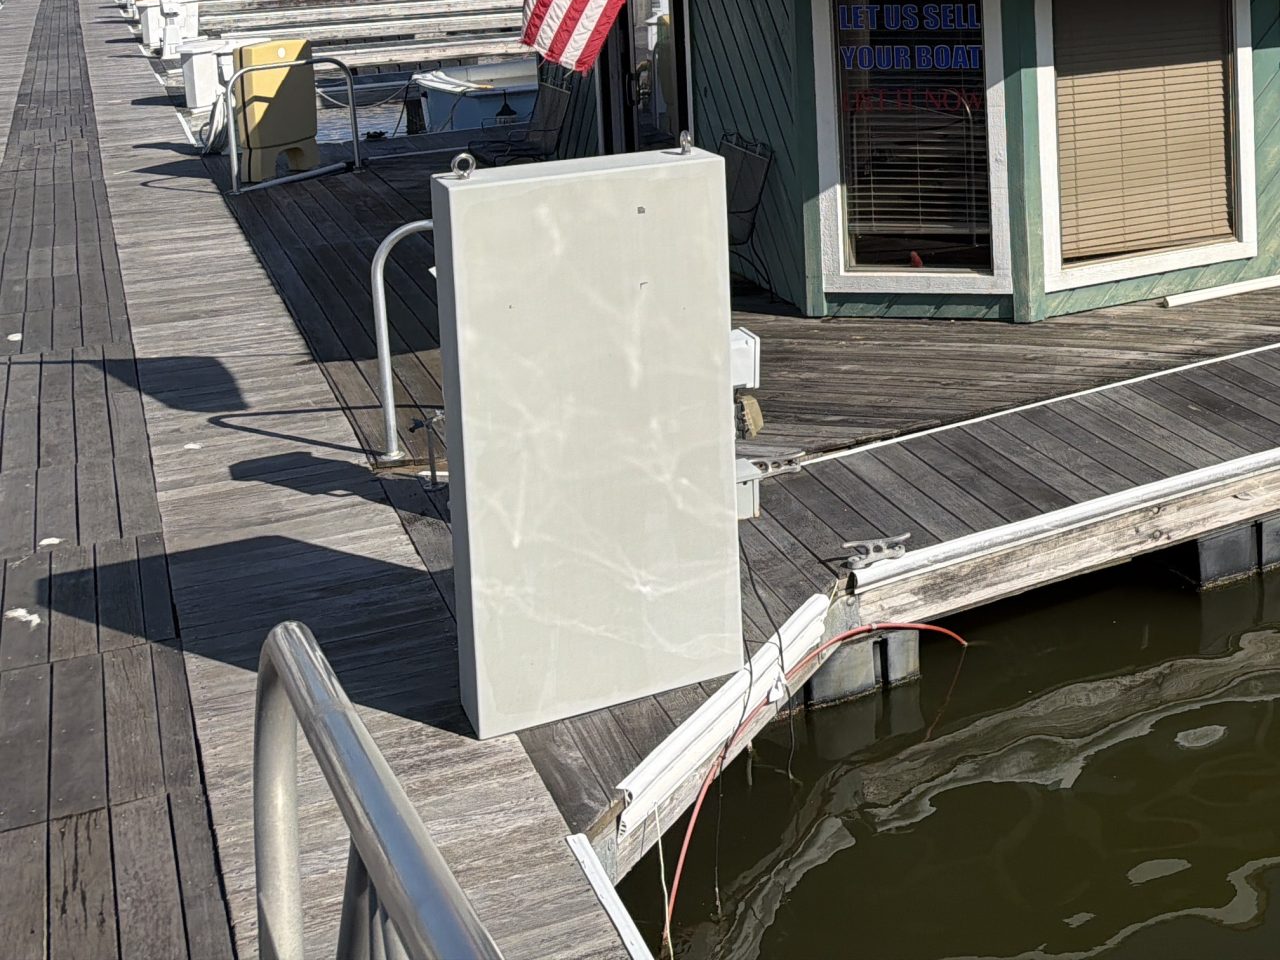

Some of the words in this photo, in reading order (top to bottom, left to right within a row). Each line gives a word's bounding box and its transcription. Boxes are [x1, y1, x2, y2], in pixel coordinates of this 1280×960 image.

[839, 5, 880, 30] LET
[884, 4, 919, 30] US
[923, 4, 981, 29] SELL
[840, 45, 911, 70] YOUR
[915, 45, 983, 70] BOAT
[924, 87, 985, 112] NOW
